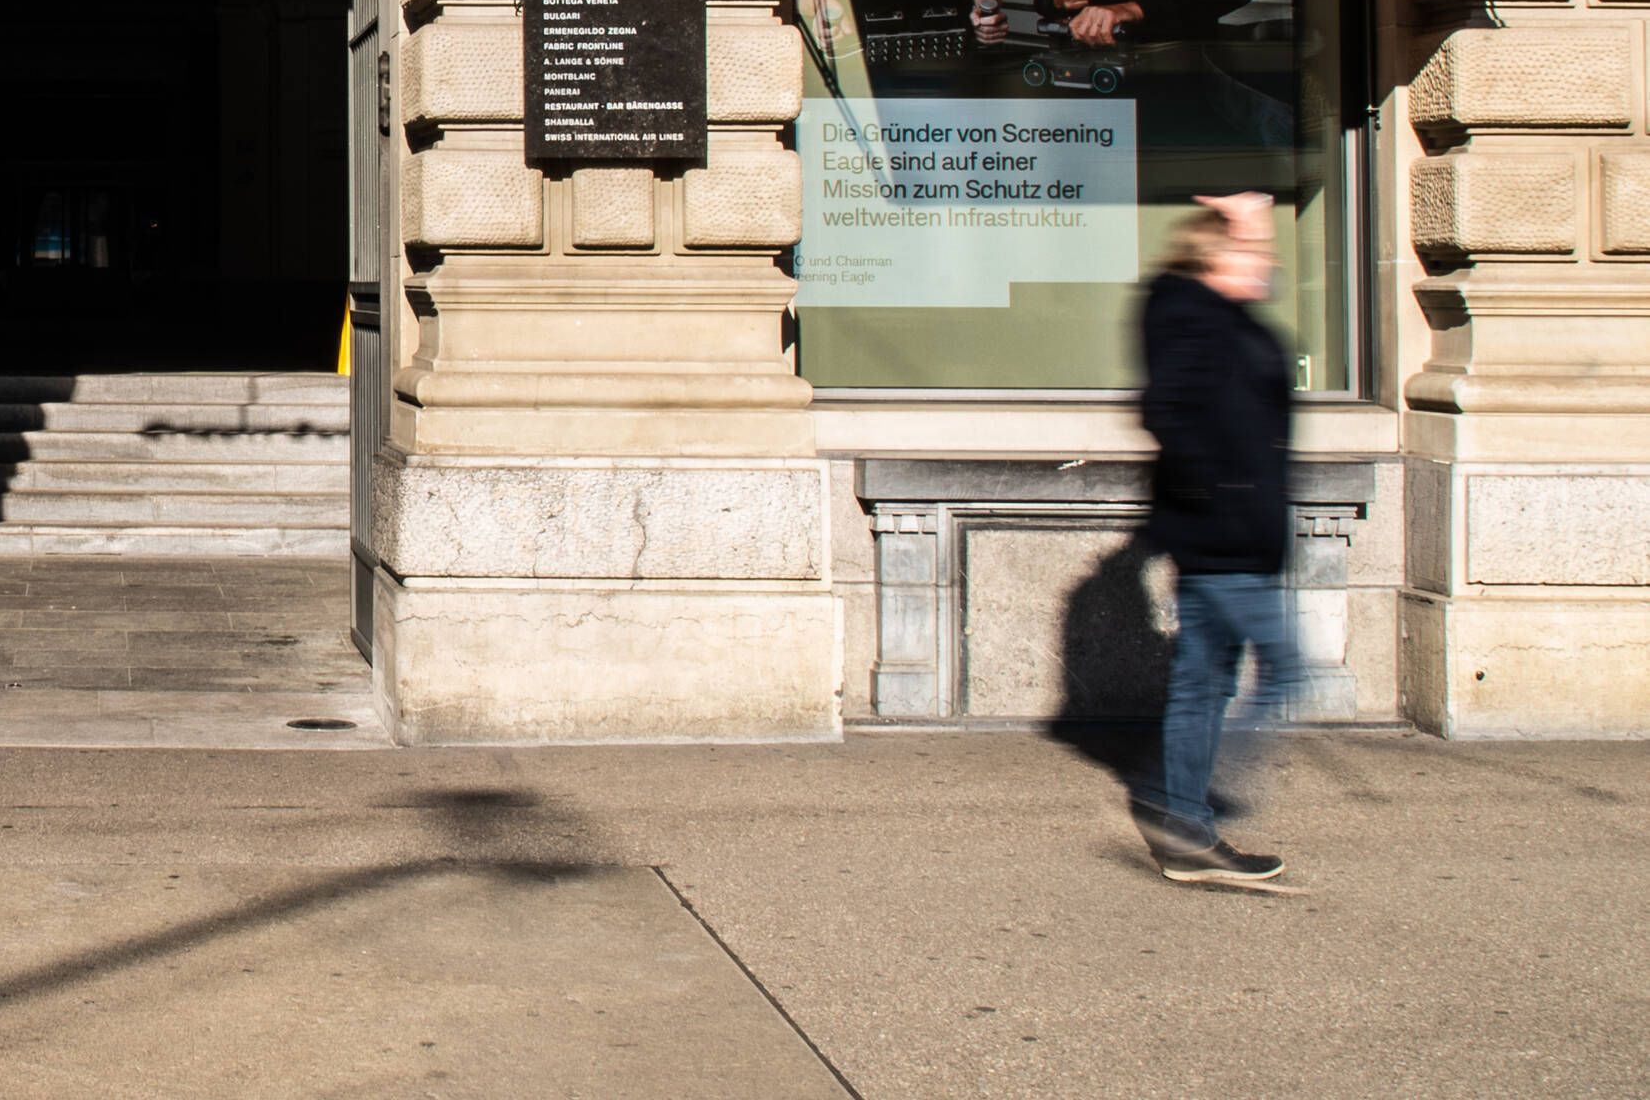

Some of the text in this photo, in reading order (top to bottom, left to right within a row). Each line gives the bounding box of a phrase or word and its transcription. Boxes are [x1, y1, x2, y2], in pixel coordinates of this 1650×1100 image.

[543, 12, 581, 20] BULGARI
[543, 27, 637, 35] ERMENEGILDO ZEGNA
[543, 42, 625, 50] FABRIC FRONTLINE
[593, 57, 625, 65] SÖHNE
[544, 88, 581, 96] PANERAI
[544, 103, 600, 111] RESTAURANT
[606, 102, 624, 110] BAR
[544, 118, 595, 126] SHAMBALLA
[544, 133, 684, 141] SWISS INTERNATIONAL AIR LINES
[823, 123, 1114, 146] Die Gründer von Screening
[823, 151, 1037, 174] Eagle sind auf einer
[823, 179, 1084, 199] Mission zum Schutz der
[823, 207, 1088, 228] weltweiten Infrastruktur.
[810, 256, 831, 267] und
[836, 255, 892, 267] Chairman
[841, 270, 875, 285] Eagle
